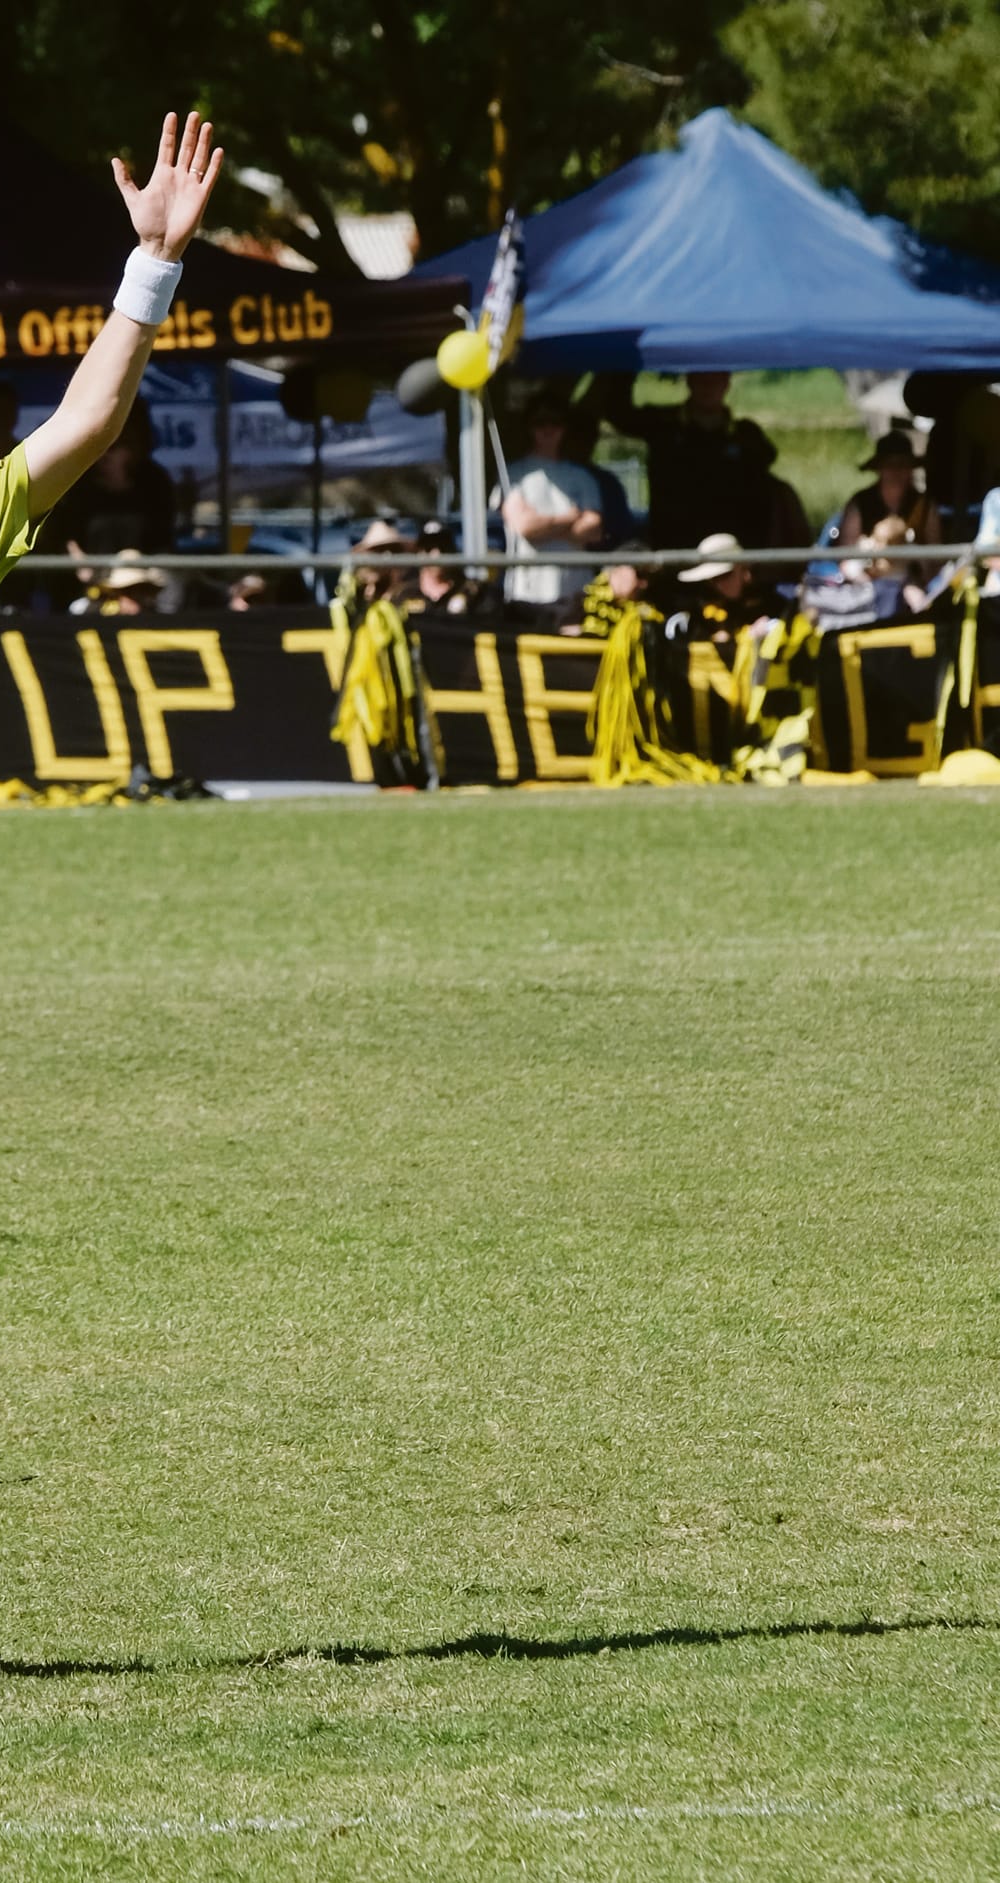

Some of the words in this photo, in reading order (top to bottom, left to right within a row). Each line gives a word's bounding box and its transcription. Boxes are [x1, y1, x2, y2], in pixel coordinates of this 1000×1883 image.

[229, 290, 333, 345] Club
[1, 629, 236, 781] UP
[282, 629, 606, 782] THE
